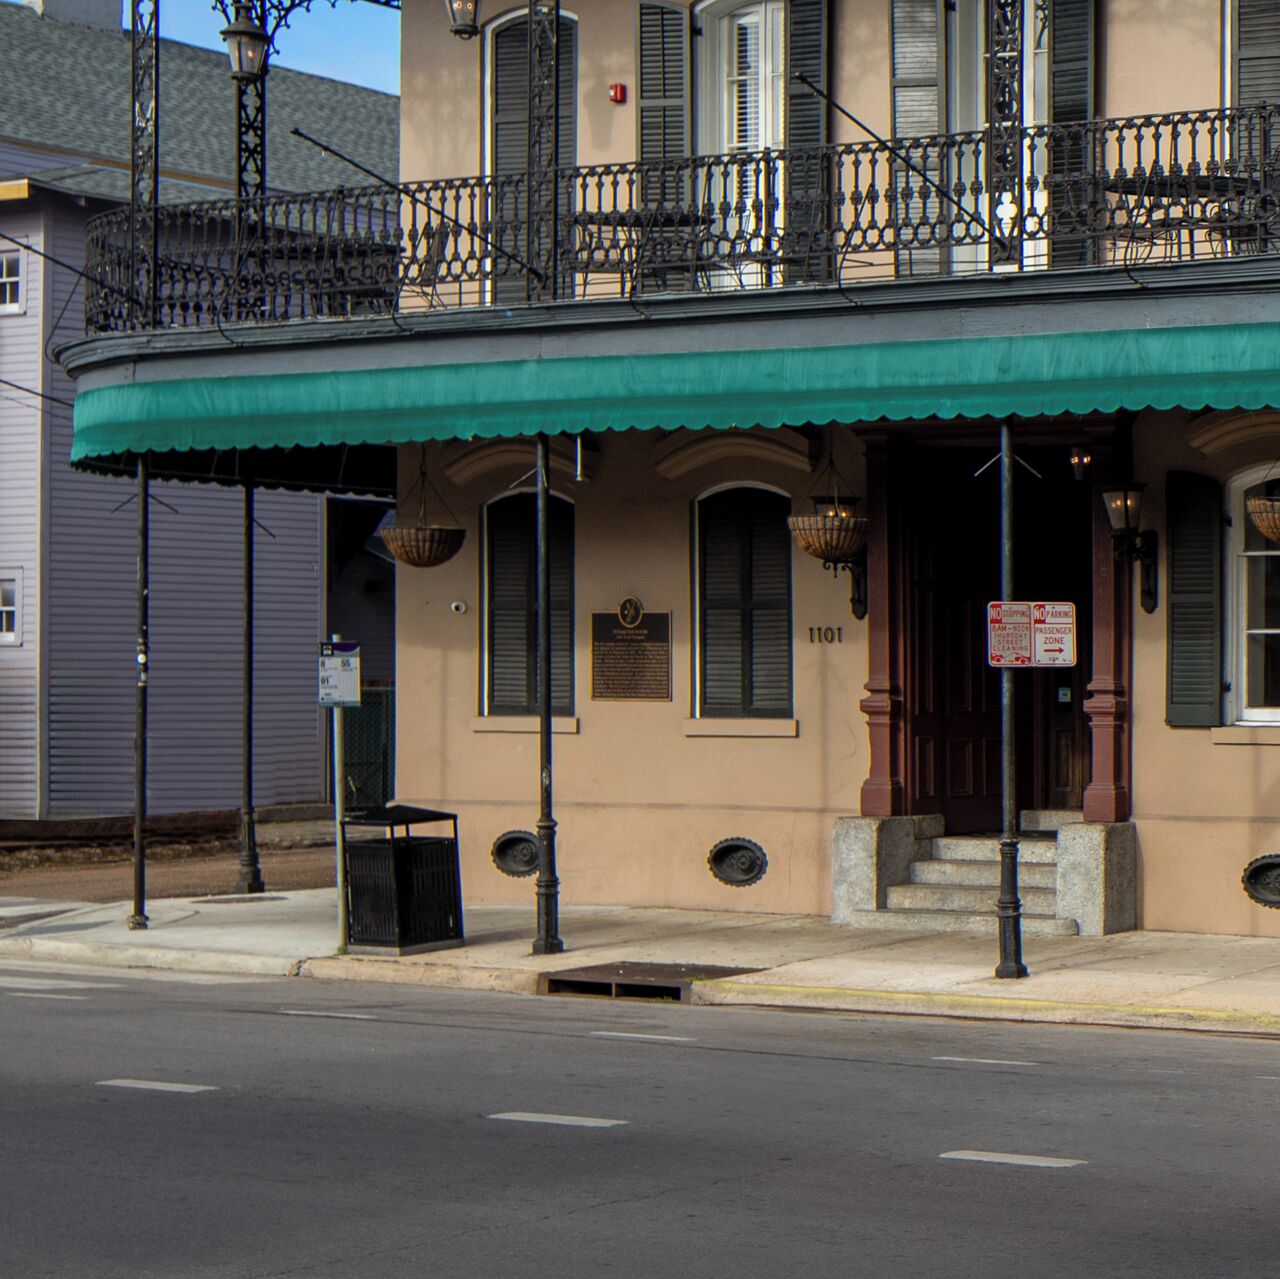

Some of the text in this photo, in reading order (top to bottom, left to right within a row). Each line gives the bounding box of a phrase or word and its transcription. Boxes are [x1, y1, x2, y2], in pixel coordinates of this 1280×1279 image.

[990, 607, 1029, 620] NO STOPPING
[1034, 607, 1072, 620] NO PARKING
[809, 627, 843, 644] 1101
[1036, 626, 1072, 634] PASSENGER
[1043, 636, 1065, 645] ZONE
